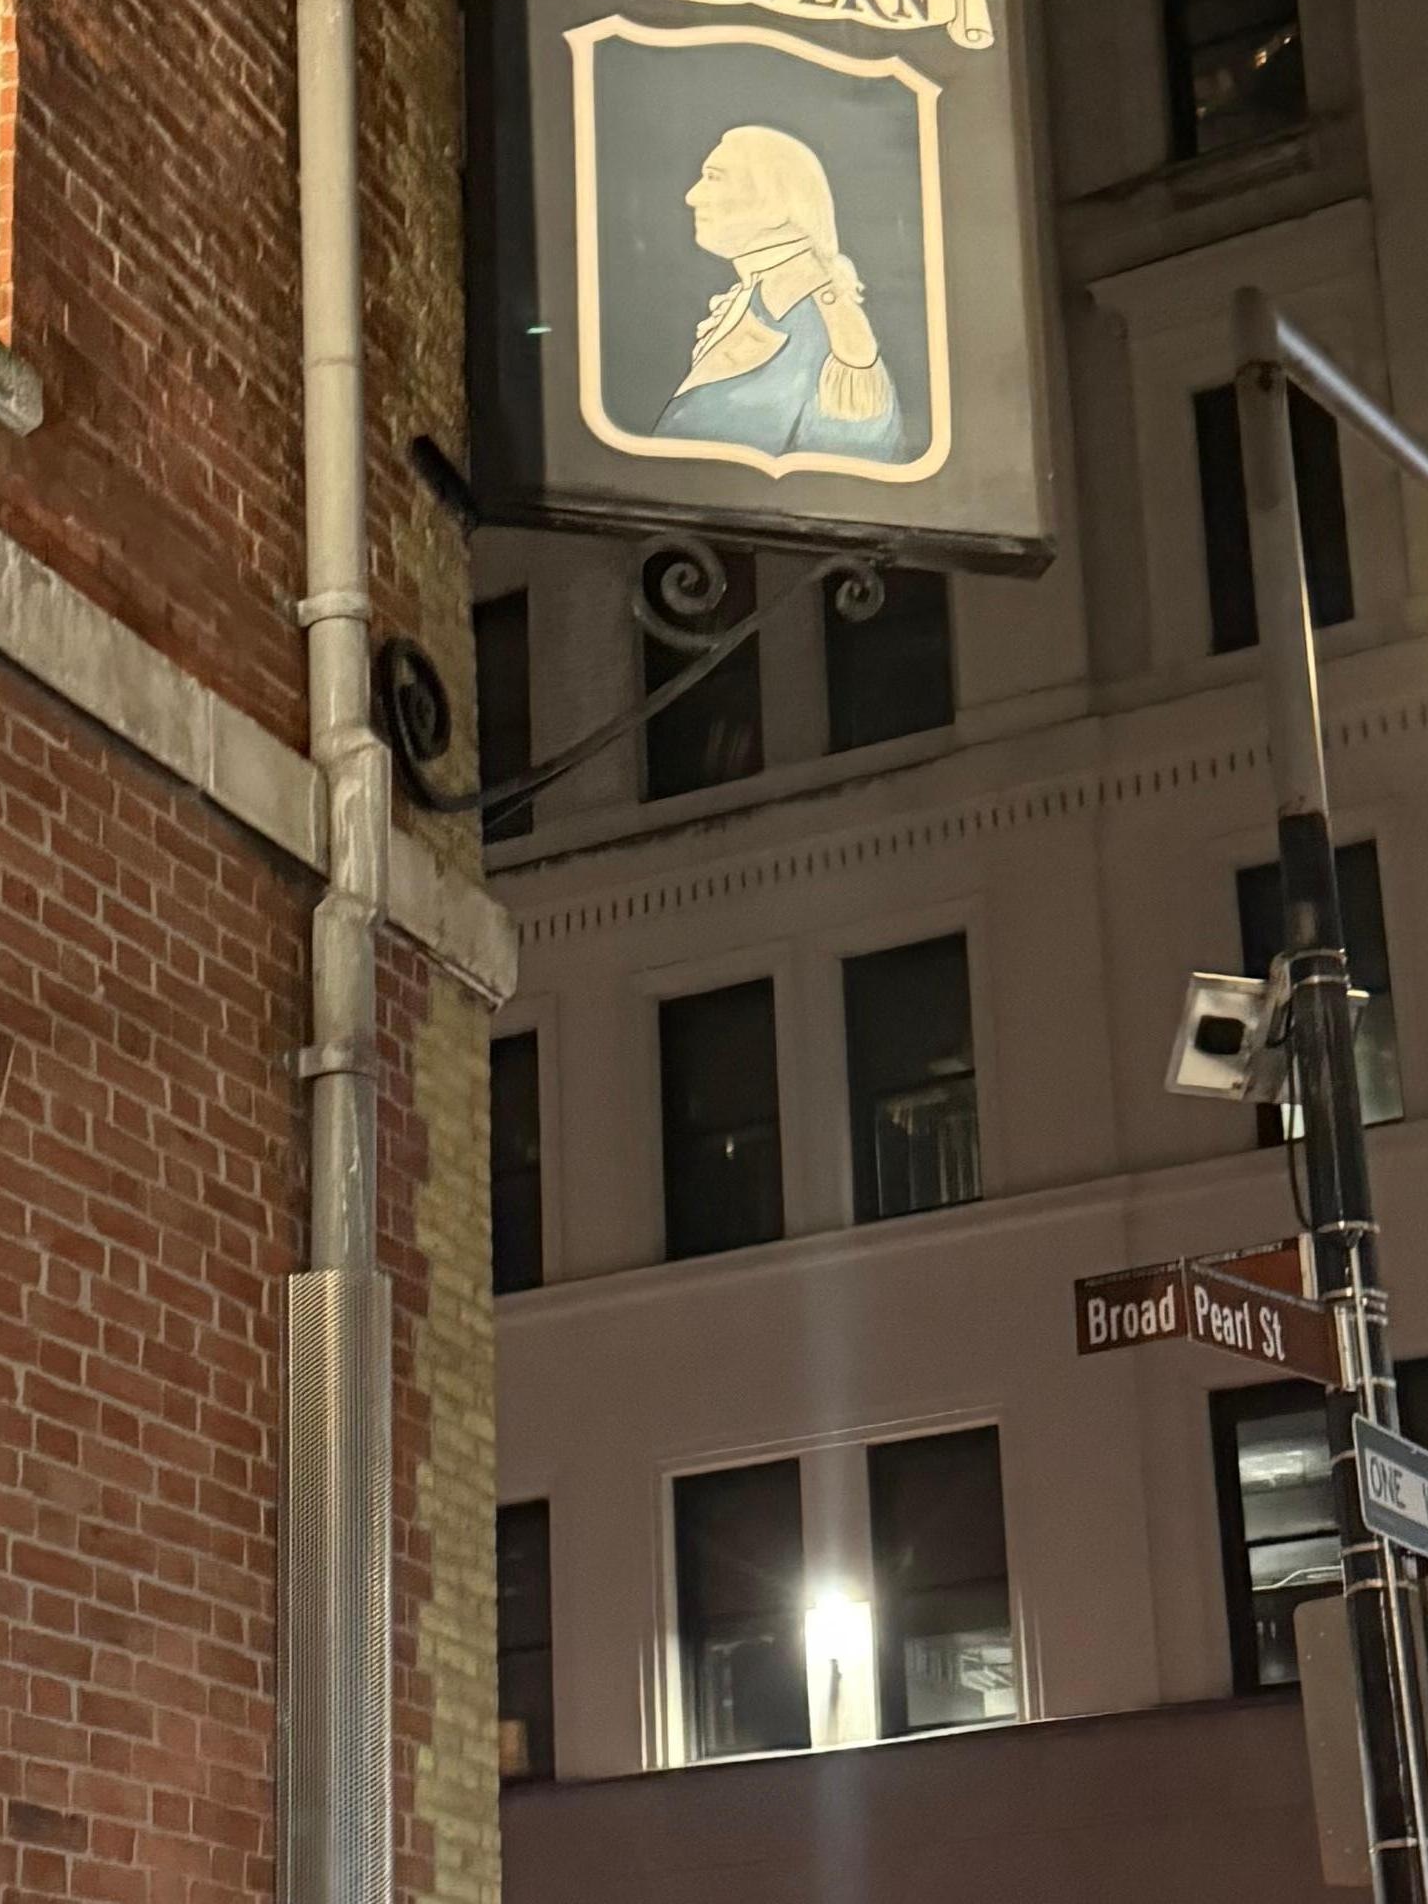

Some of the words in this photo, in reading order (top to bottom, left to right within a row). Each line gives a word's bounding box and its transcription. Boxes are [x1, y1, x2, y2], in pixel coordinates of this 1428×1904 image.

[1087, 1283, 1176, 1346] Broad
[1193, 1283, 1253, 1351] Pearl
[1258, 1305, 1286, 1361] St
[1370, 1455, 1406, 1510] ONE
